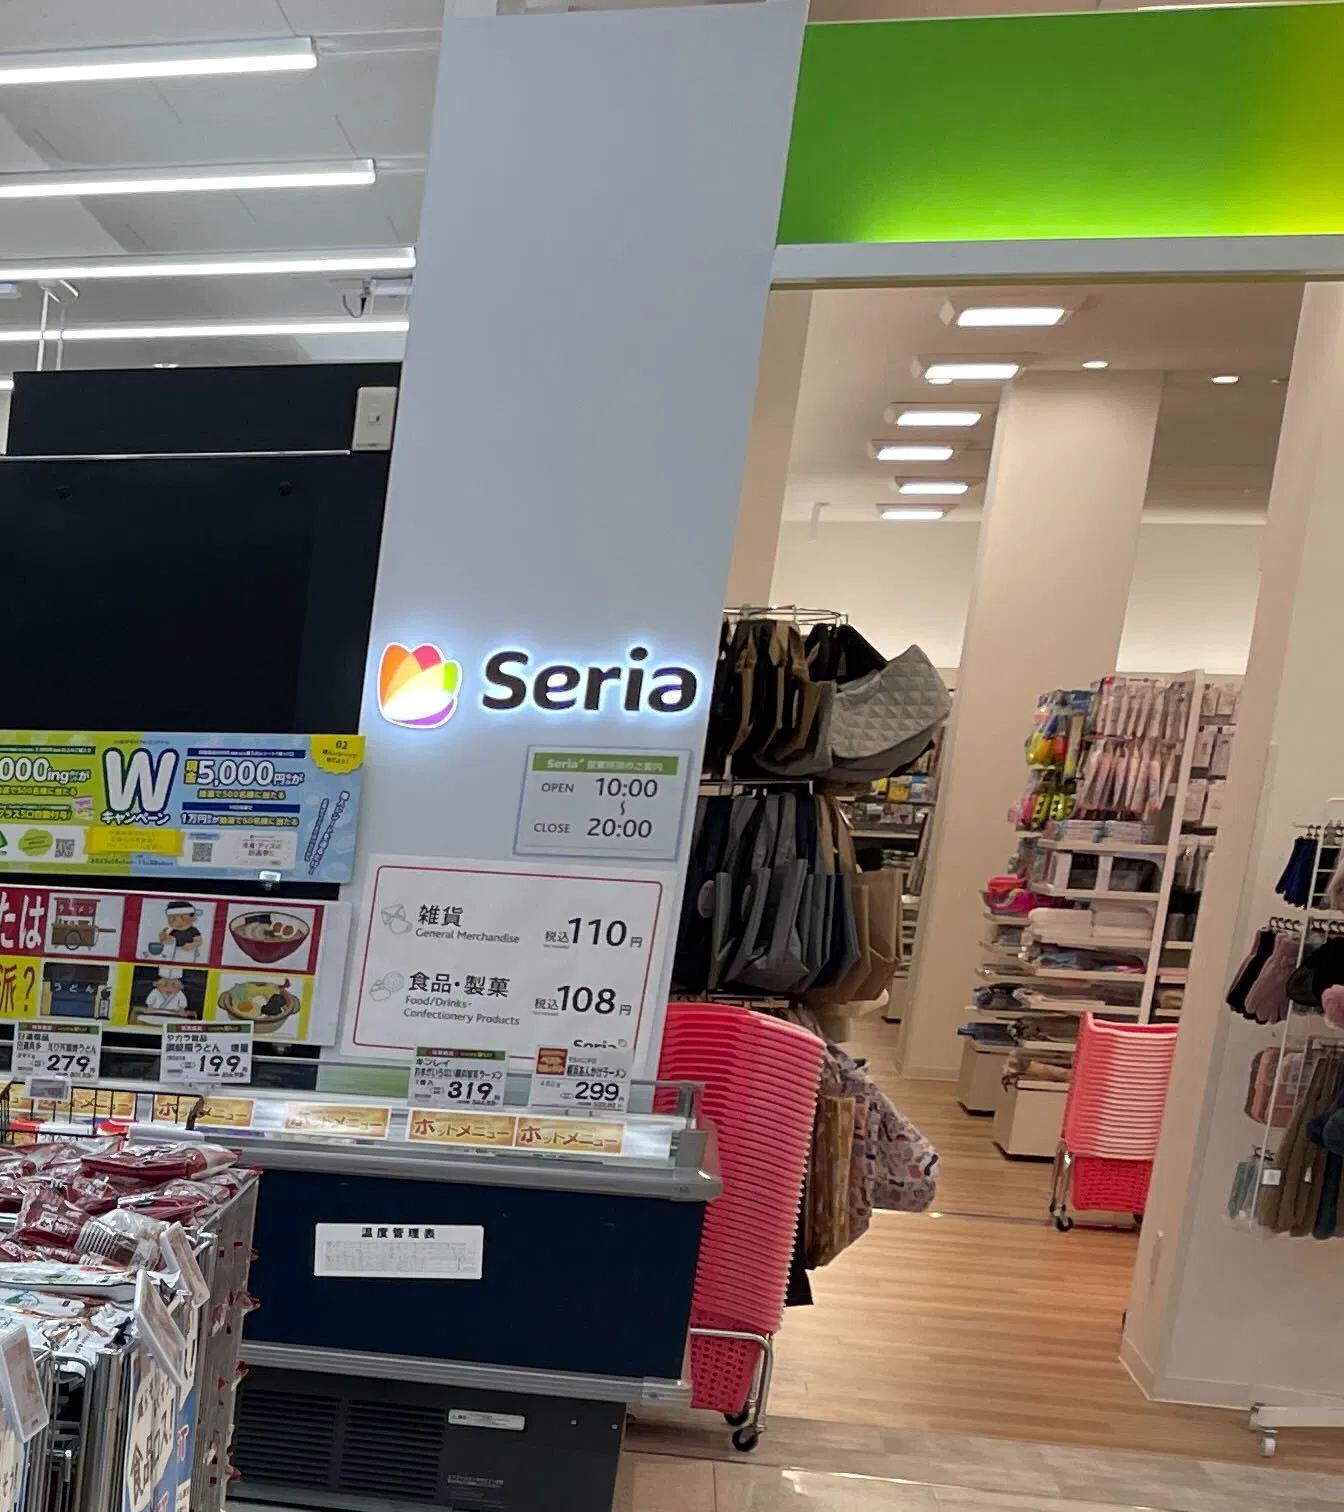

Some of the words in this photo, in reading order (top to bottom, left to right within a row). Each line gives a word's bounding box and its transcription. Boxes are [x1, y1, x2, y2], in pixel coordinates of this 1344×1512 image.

[481, 646, 698, 714] Seria
[547, 758, 579, 770] Seria
[103, 748, 179, 813] W
[541, 782, 575, 793] OPEN
[595, 777, 658, 798] 10:00
[100, 811, 171, 826] キャンペーン
[533, 822, 571, 834] CLOSE
[587, 817, 653, 838] 20:00
[417, 904, 464, 928] 雑貨
[415, 928, 455, 943] General
[457, 931, 520, 946] Merchandise
[543, 929, 569, 943] 税込
[567, 917, 627, 948] 110
[630, 935, 643, 949] 円
[53, 982, 95, 994] うどん
[408, 972, 511, 999] 食品・製菓
[533, 996, 559, 1012] 税込
[557, 984, 616, 1016] 108
[619, 1003, 632, 1017] 円
[403, 1006, 470, 1023] Confectionery
[472, 1012, 520, 1027] Products
[45, 1053, 91, 1072] 279
[198, 1054, 242, 1074] 199
[447, 1080, 494, 1101] 319
[574, 1081, 620, 1102] 299
[414, 1118, 510, 1140] ホットメニュー
[520, 1125, 619, 1146] ホットメニュー
[361, 1227, 436, 1240] 温度管理表
